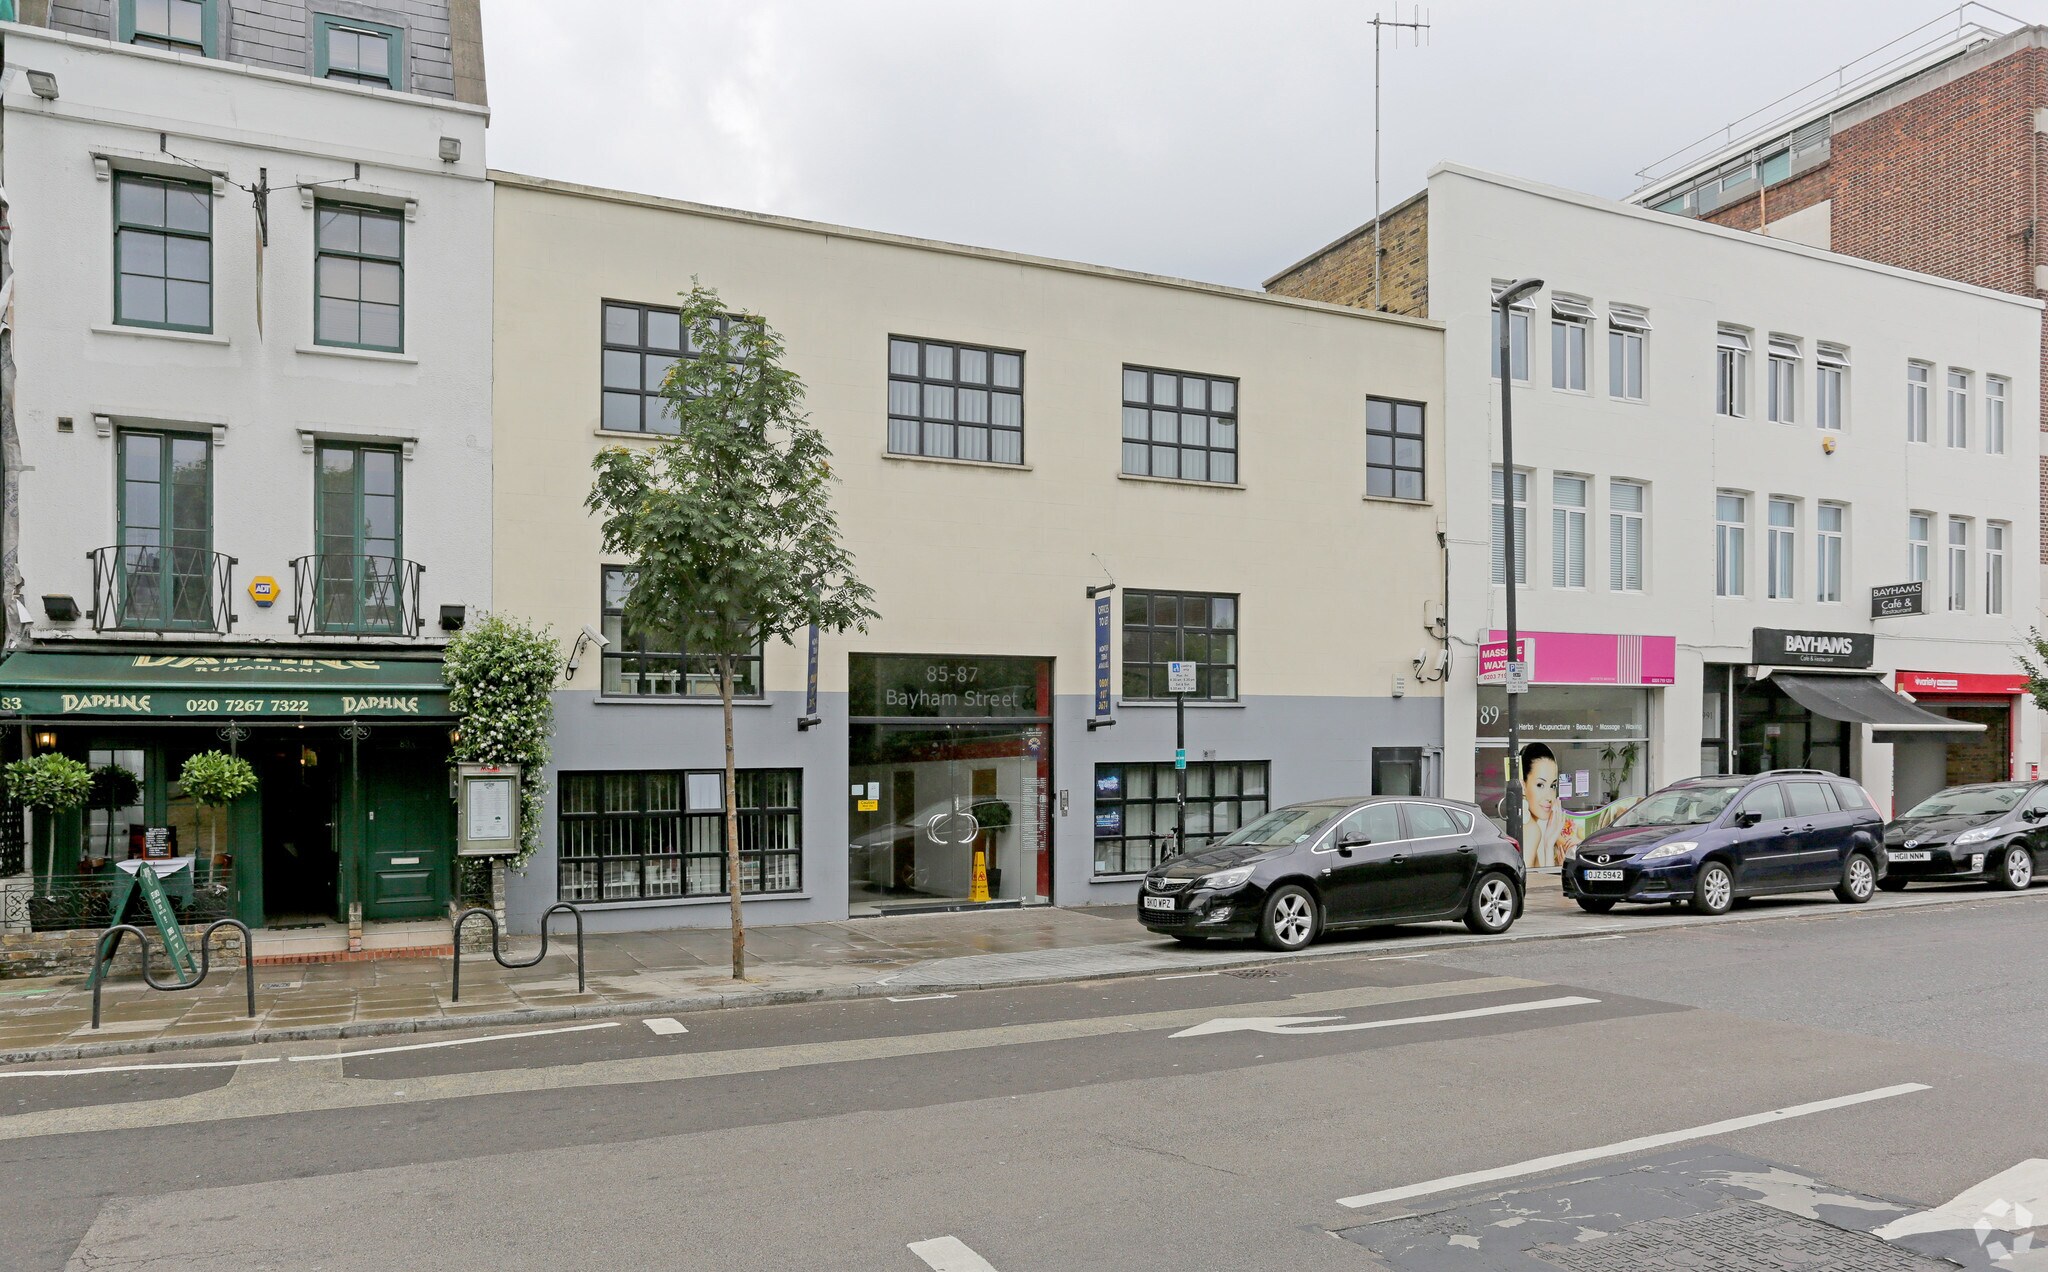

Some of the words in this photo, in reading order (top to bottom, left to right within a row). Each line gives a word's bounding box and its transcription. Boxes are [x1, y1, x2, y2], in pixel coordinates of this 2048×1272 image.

[256, 584, 270, 593] ADT
[1873, 584, 1921, 597] BAYHAMS
[1904, 598, 1912, 607] &
[1785, 635, 1853, 655] BAYHAMS
[1482, 646, 1522, 659] MASSE
[927, 666, 978, 682] 85-87
[2, 697, 22, 710] 83
[61, 694, 151, 713] DAPHNE
[342, 696, 418, 714] DAPHNE
[886, 689, 957, 709] Bayham
[964, 690, 1018, 707] Street
[186, 700, 219, 712] 020
[225, 700, 264, 712] 7267
[271, 700, 309, 712] 7322
[1480, 705, 1499, 725] 89
[1539, 723, 1570, 731] Acupuncture
[1576, 723, 1593, 731] Beauty
[1600, 723, 1620, 731] Massage
[1603, 871, 1622, 879] 5942
